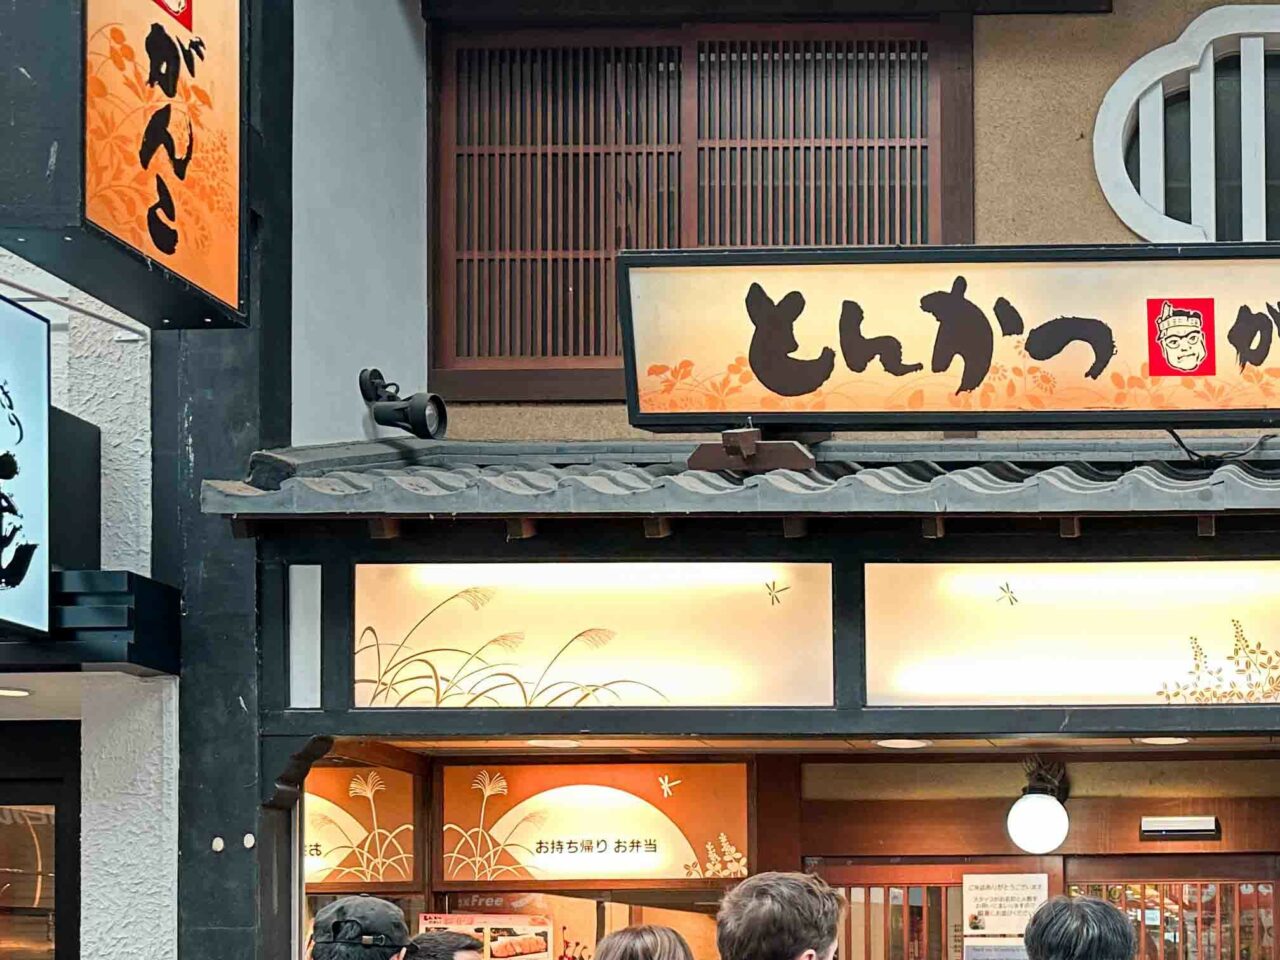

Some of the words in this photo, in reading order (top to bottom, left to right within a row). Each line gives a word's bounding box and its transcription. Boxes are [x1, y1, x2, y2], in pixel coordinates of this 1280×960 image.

[139, 22, 207, 255] がんこ
[745, 275, 1118, 396] とんかつ
[535, 839, 608, 854] お持ち帰り
[613, 838, 658, 853] お弁当
